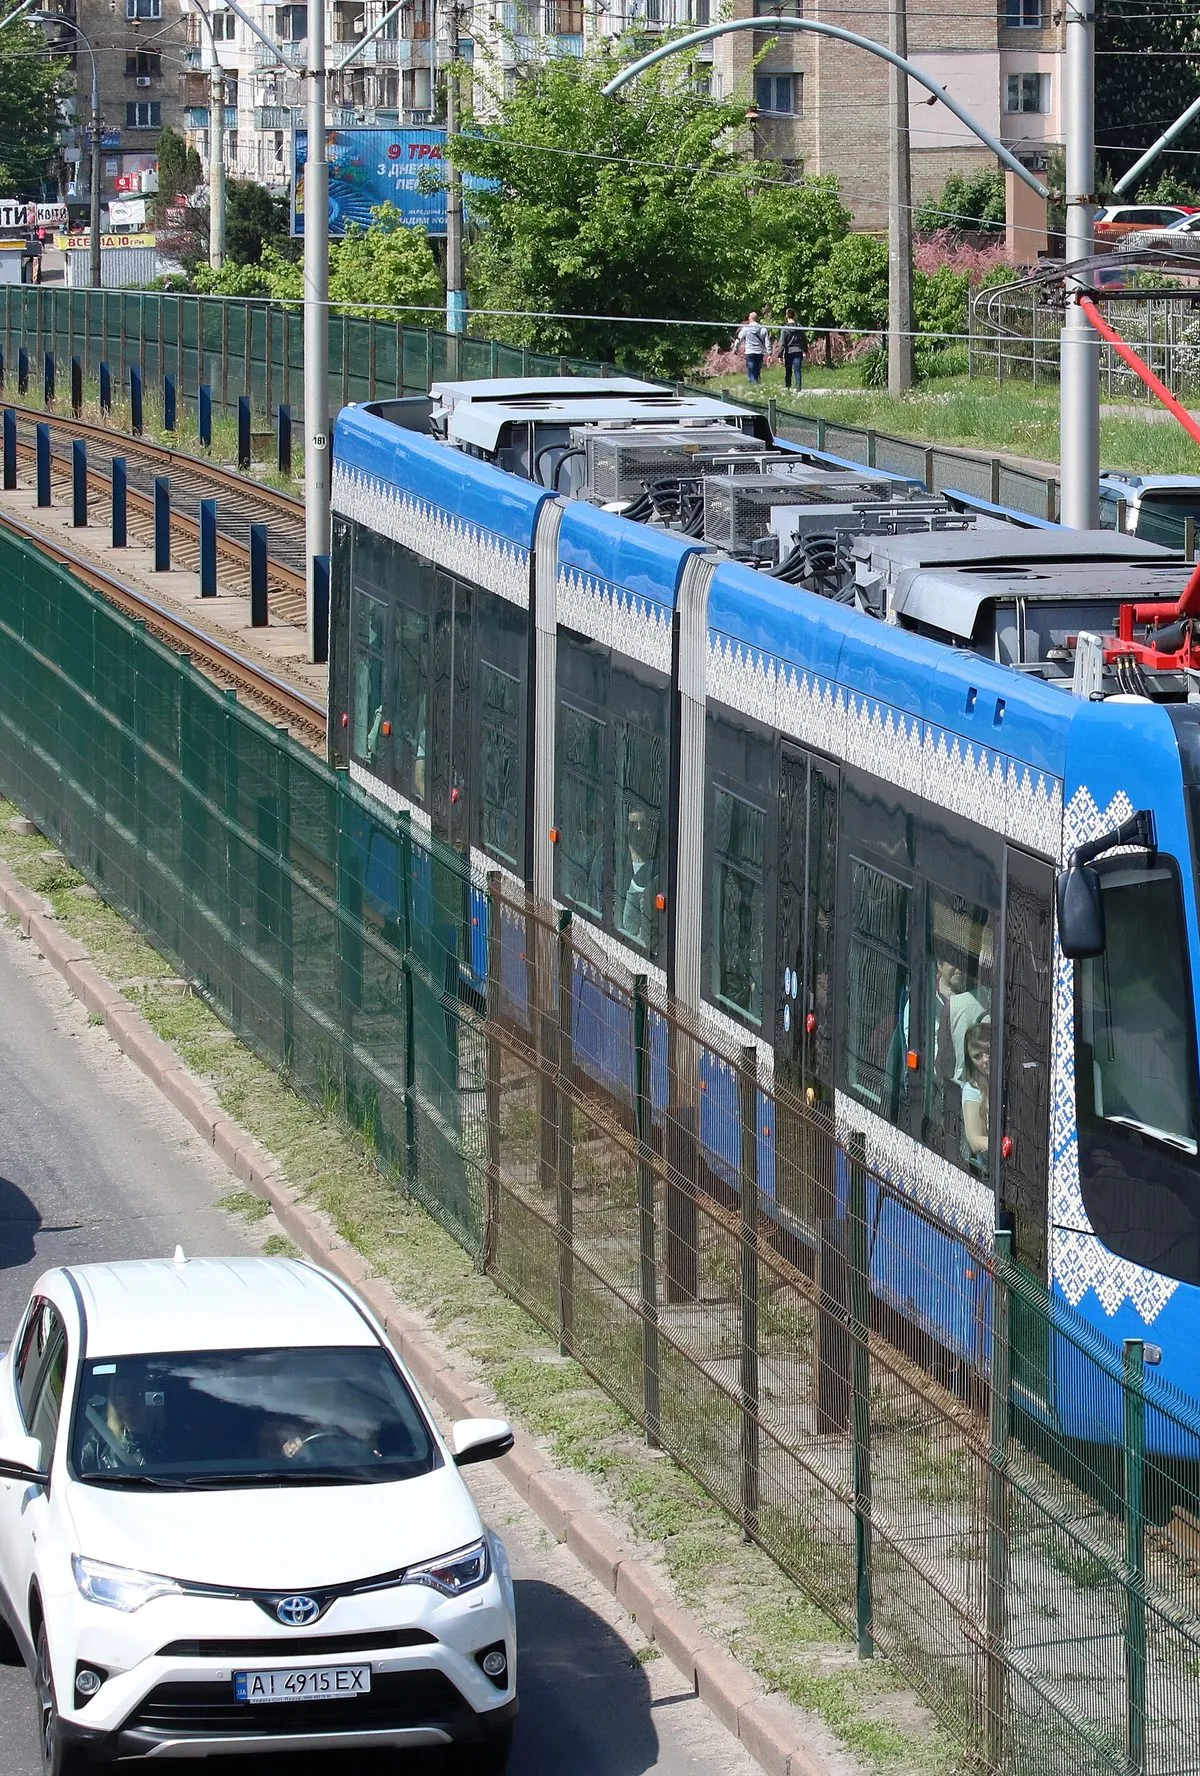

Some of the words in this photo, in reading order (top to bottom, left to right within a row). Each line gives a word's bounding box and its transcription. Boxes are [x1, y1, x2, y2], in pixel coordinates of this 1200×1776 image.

[388, 144, 401, 160] 9
[408, 144, 442, 160] ТРА
[68, 238, 91, 247] ВСЕ
[313, 437, 325, 445] 181
[252, 1675, 274, 1695] AI
[284, 1673, 330, 1693] 4915
[335, 1670, 363, 1690] EX
